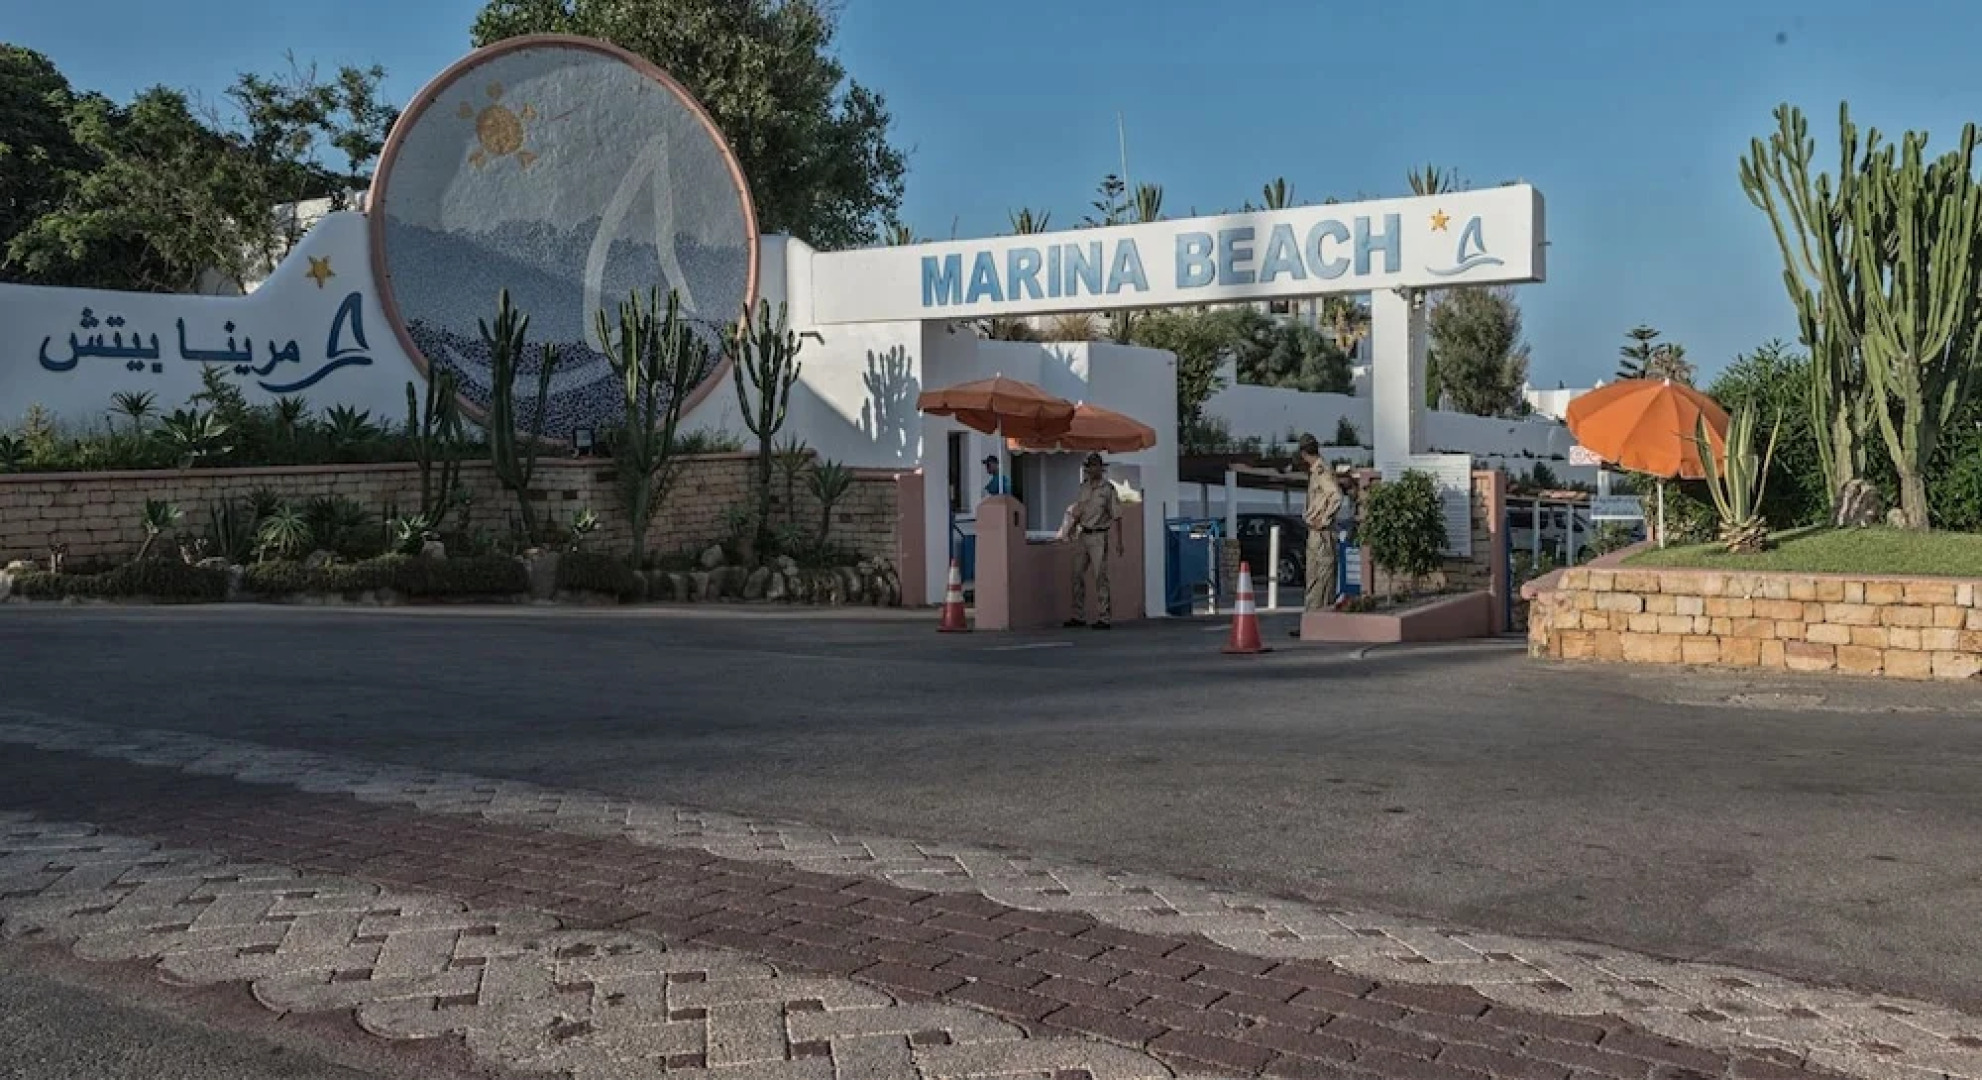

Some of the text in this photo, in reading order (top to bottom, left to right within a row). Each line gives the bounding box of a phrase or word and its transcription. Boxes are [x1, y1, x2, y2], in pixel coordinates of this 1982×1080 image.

[921, 214, 1402, 307] MARINA BEACH
[39, 307, 300, 376] مرينا بيتش
